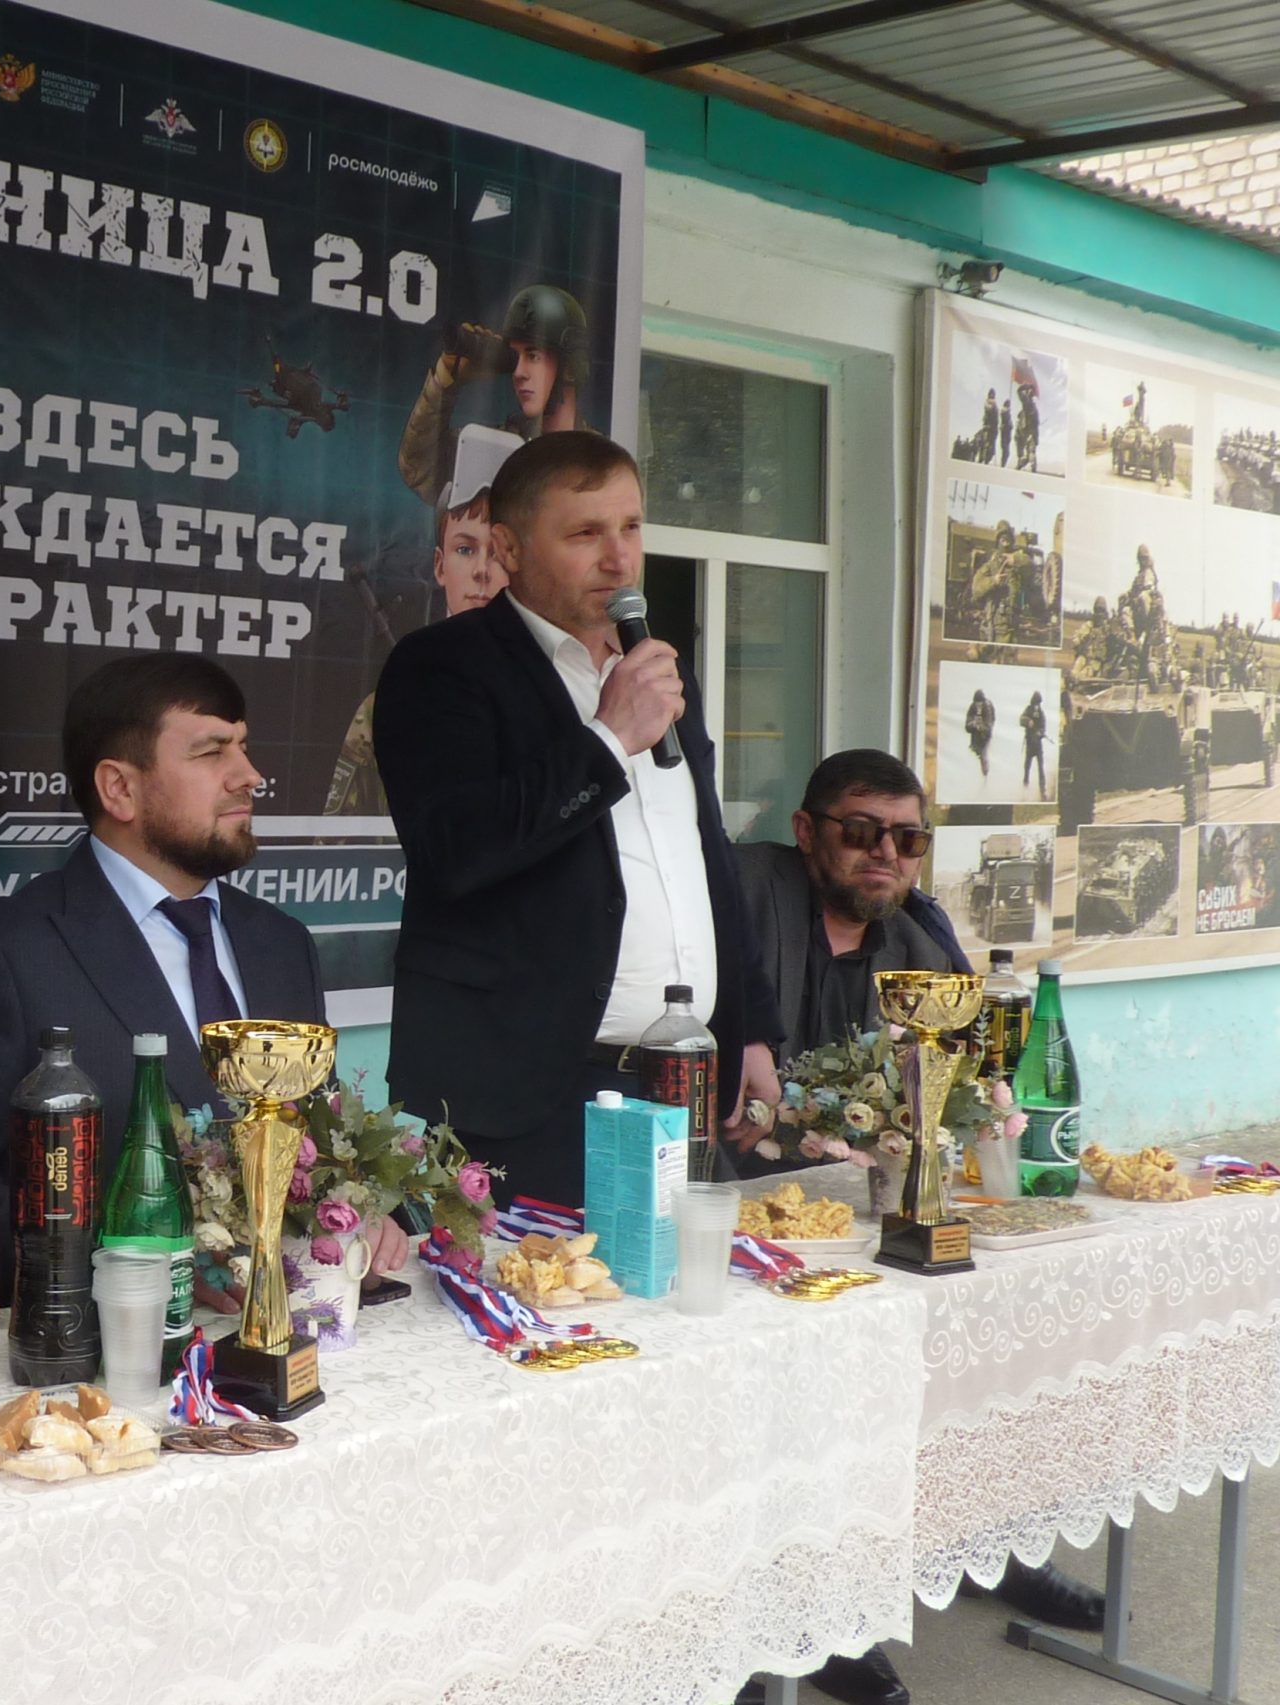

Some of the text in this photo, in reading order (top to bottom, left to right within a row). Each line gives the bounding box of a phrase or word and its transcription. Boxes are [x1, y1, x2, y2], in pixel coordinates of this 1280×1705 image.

[328, 153, 439, 192] росмолодёжь
[311, 232, 438, 325] 2.0
[50, 1146, 68, 1192] deneb
